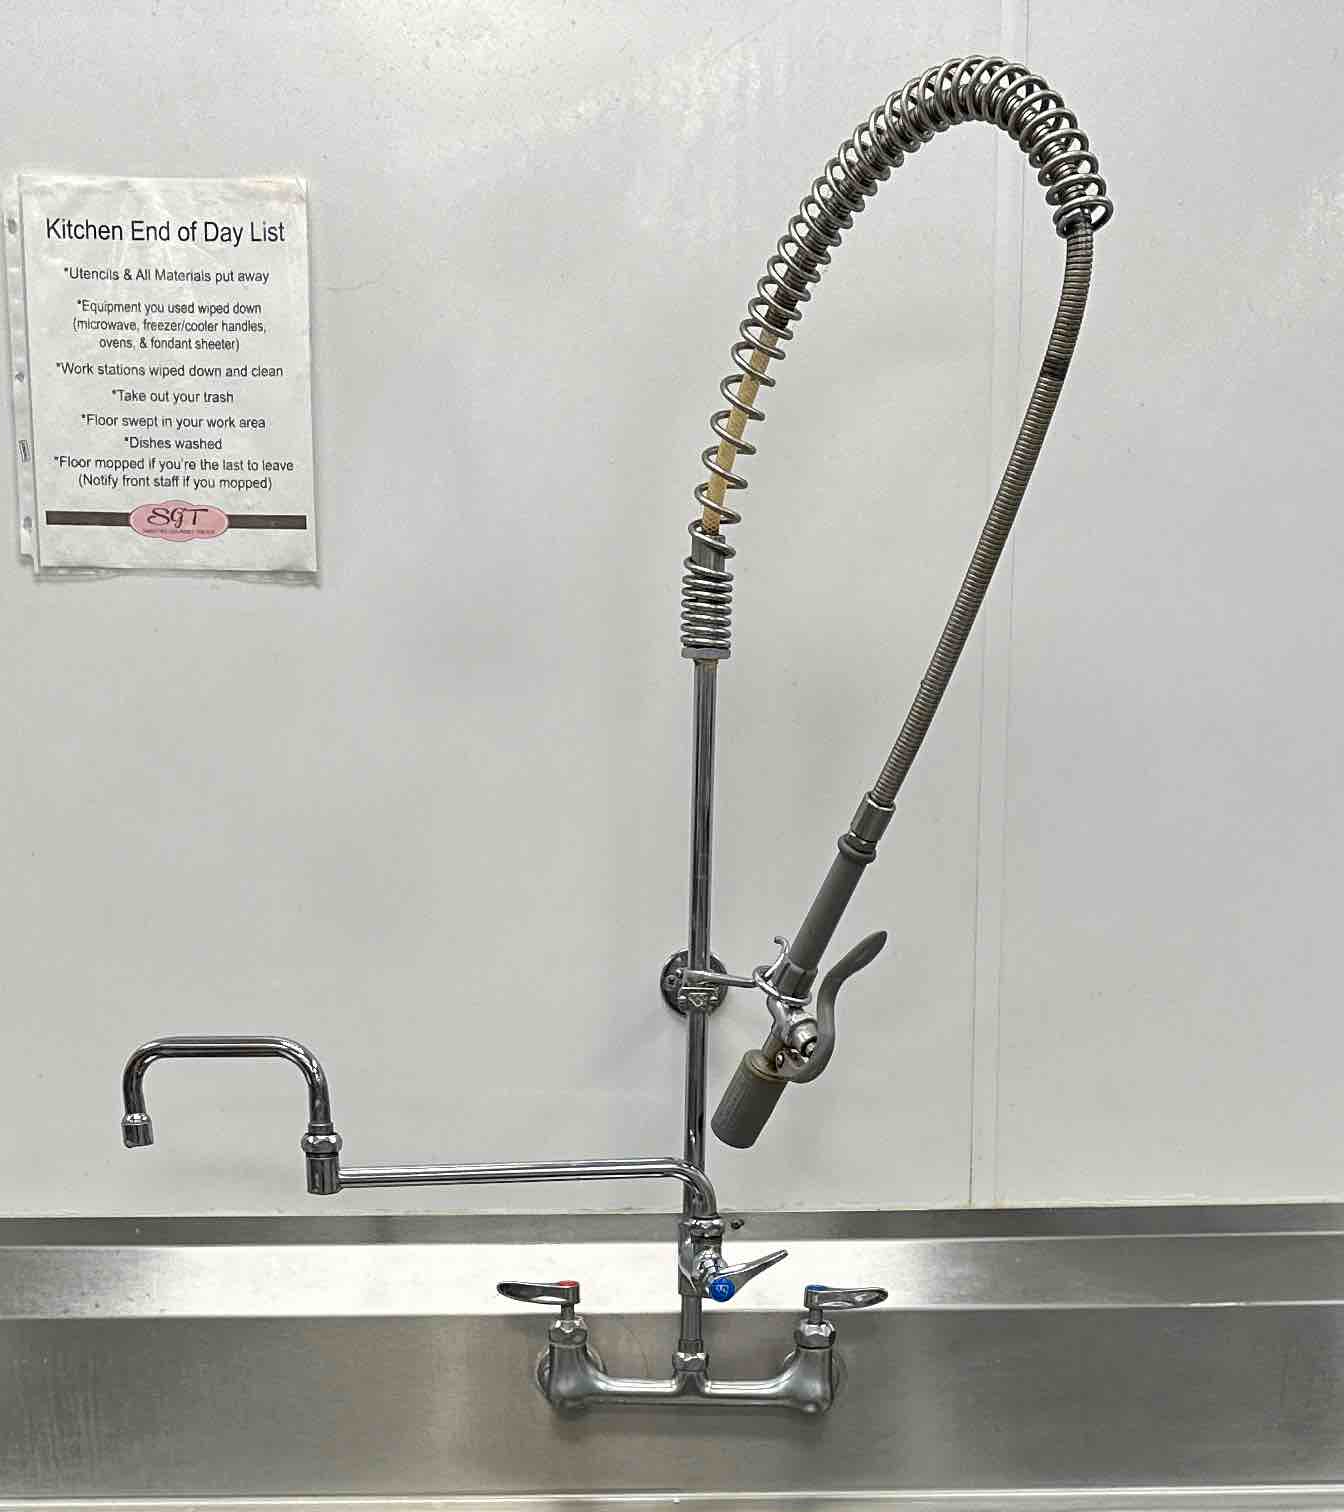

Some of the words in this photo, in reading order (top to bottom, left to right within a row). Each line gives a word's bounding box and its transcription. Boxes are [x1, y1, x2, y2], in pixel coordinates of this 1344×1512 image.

[46, 217, 123, 241] Kitchen
[131, 220, 170, 241] End
[177, 220, 197, 242] of
[205, 221, 243, 247] Day
[250, 221, 285, 242] List
[123, 268, 132, 281] &
[135, 268, 151, 281] All
[155, 269, 210, 282] Materials
[215, 271, 234, 285] put
[237, 272, 269, 285] away
[144, 304, 165, 316] you
[168, 302, 194, 314] used
[198, 303, 230, 316] wiped
[233, 303, 261, 314] down
[143, 319, 218, 333] freezer/cooler
[139, 337, 147, 349] &
[151, 337, 192, 350] fondant
[195, 338, 240, 352] sheeter)
[97, 363, 145, 376] stations
[149, 364, 185, 378] wiped
[189, 364, 222, 377] down
[225, 365, 248, 377] and
[251, 365, 283, 377] clean
[150, 391, 169, 402] out
[172, 392, 200, 405] your
[204, 391, 234, 403] trash
[122, 415, 158, 430] swept
[161, 415, 173, 427] in
[175, 418, 203, 430] your
[207, 416, 236, 428] work
[239, 418, 266, 429] area
[175, 438, 222, 450] washed
[95, 457, 144, 472] mopped
[148, 457, 158, 470] if
[159, 458, 196, 473] you're
[200, 459, 219, 471] the
[222, 459, 244, 471] last
[247, 460, 259, 471] to
[262, 460, 294, 472] leave
[78, 475, 118, 488] (Notify
[122, 475, 150, 487] front
[153, 475, 179, 488] staff
[182, 476, 191, 488] if
[193, 478, 215, 490] you
[219, 477, 272, 491] mopped)
